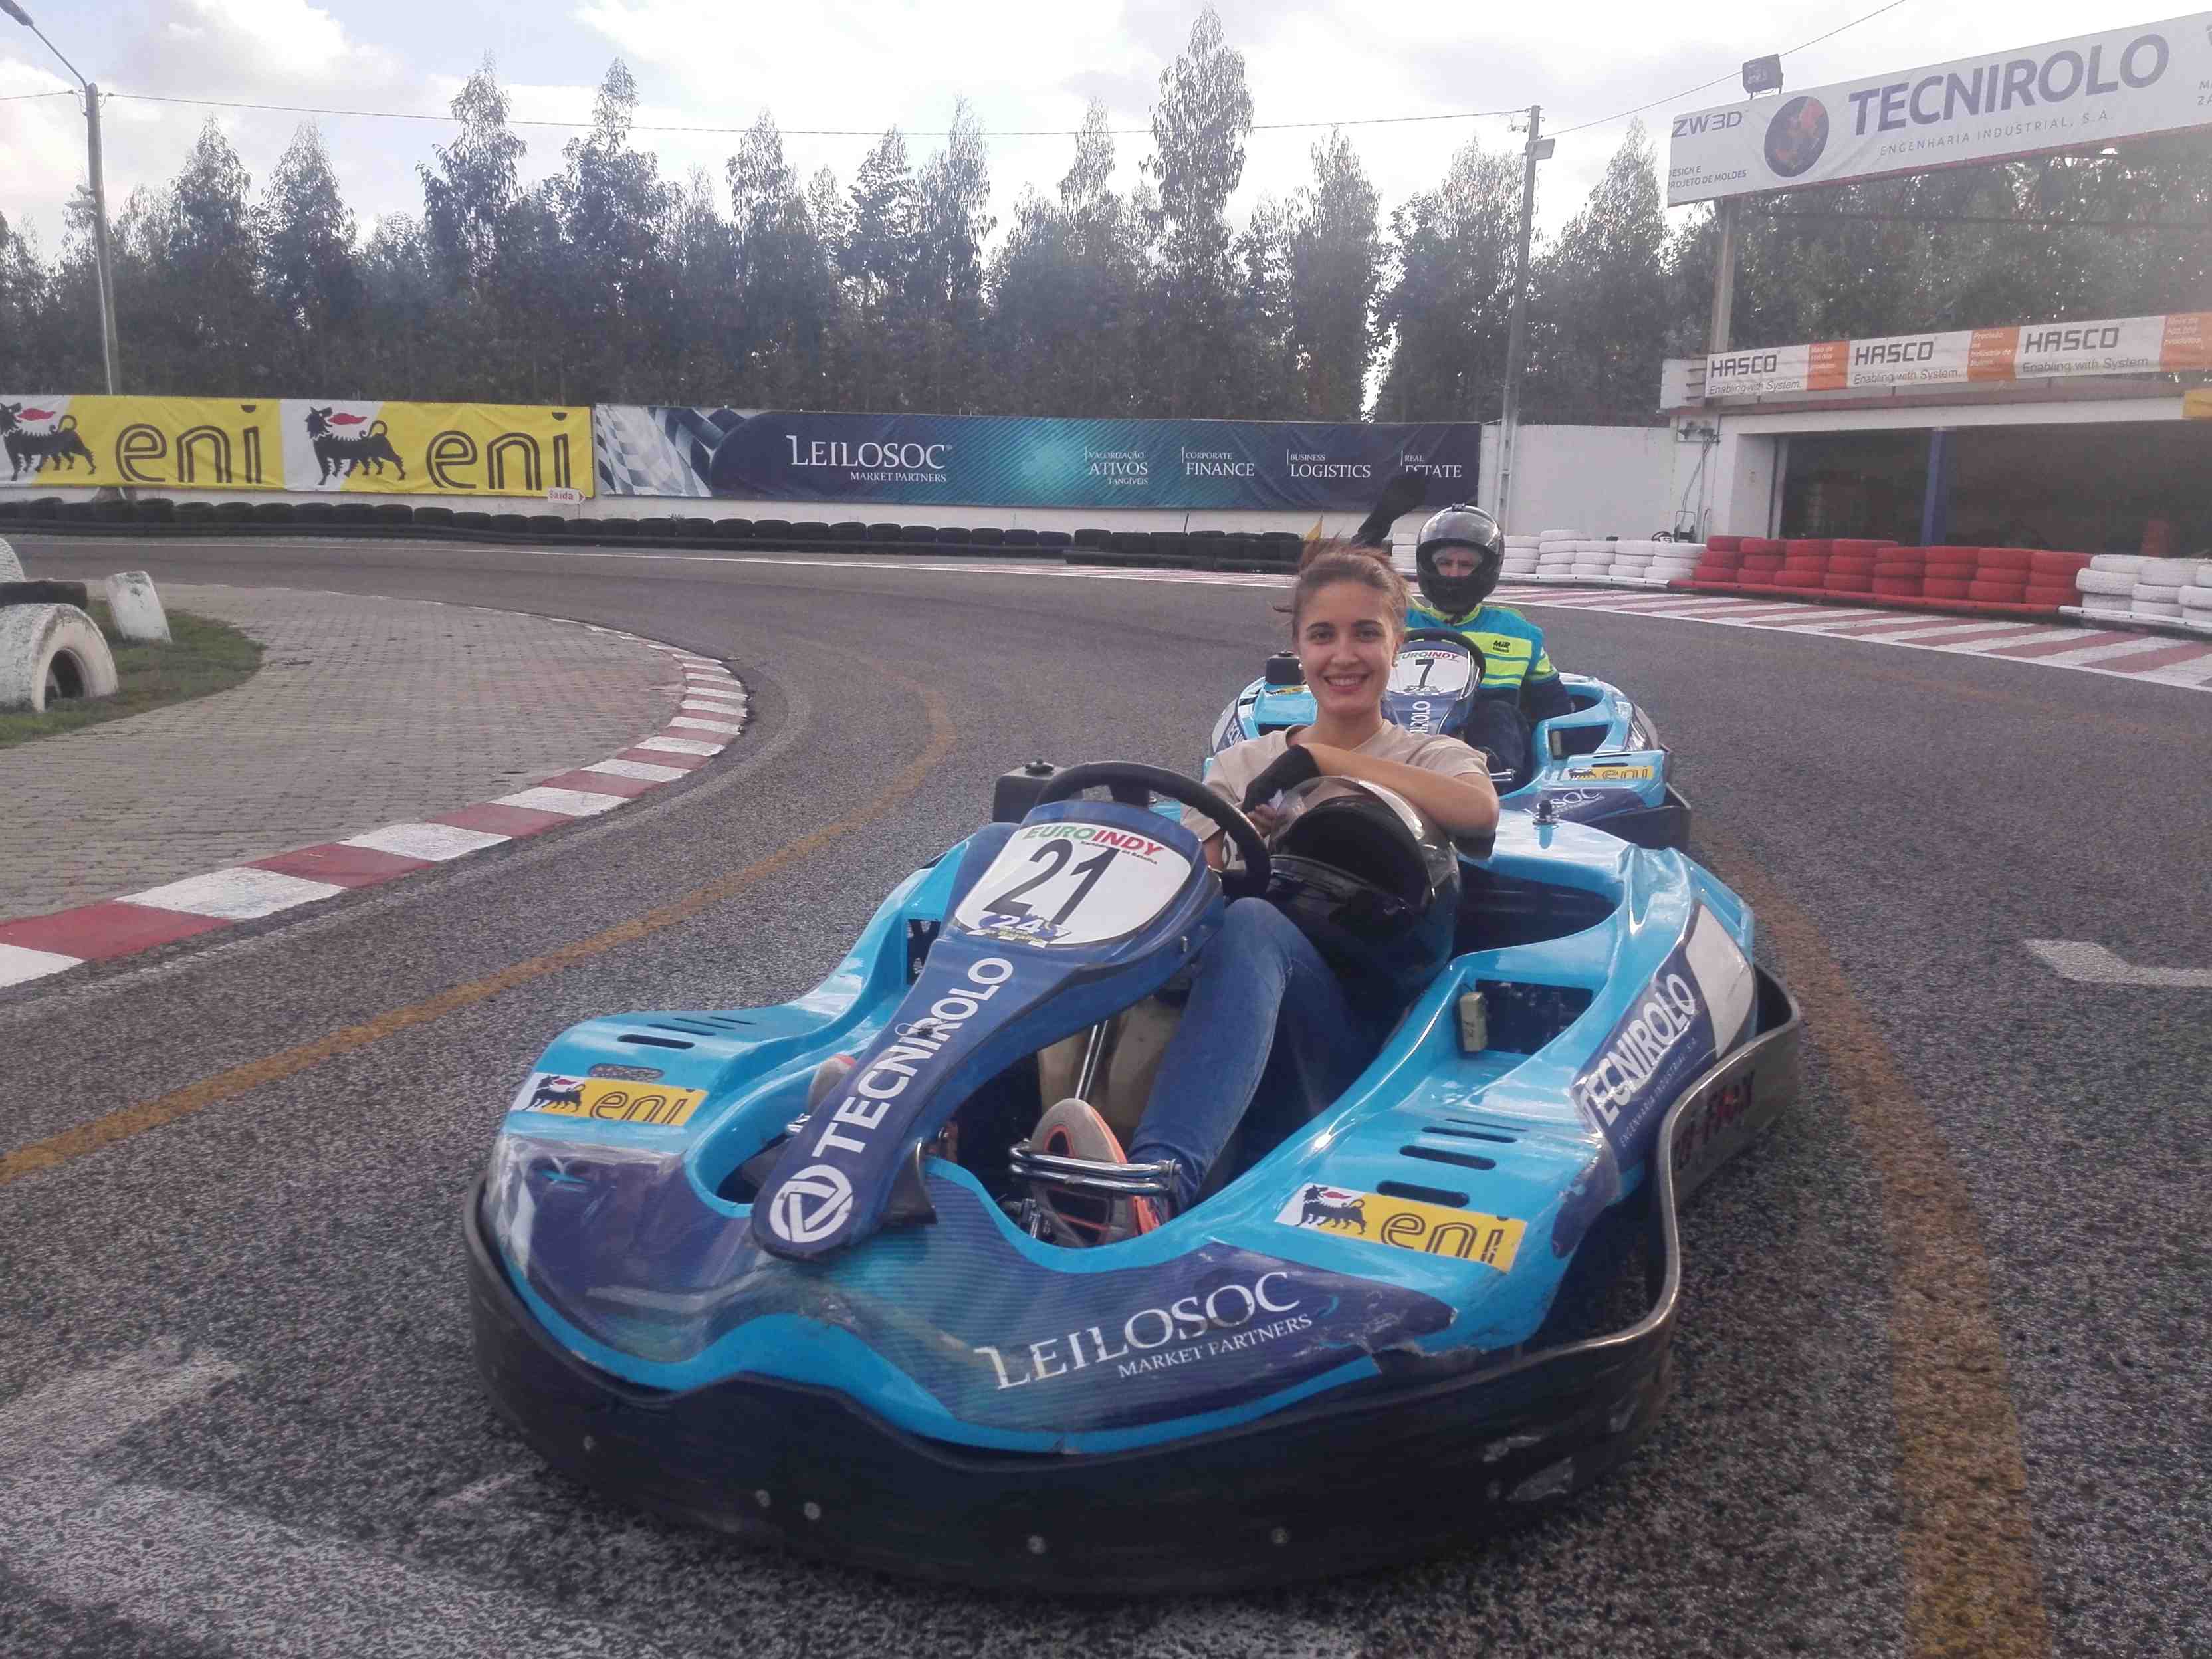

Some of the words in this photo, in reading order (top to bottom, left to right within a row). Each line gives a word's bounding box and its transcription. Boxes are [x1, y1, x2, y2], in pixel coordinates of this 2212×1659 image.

[1848, 33, 2169, 136] TECNIROLO
[1672, 110, 1743, 138] ZW3D
[1880, 132, 1970, 156] ENGENHARIA
[1977, 116, 2074, 141] INDUSTRIAL,
[1714, 169, 1747, 182] MOLDES
[1855, 341, 1934, 366] HASCO
[2025, 327, 2120, 353] HASCO
[1711, 354, 1777, 378] HASCO
[1854, 373, 1894, 385] Enabling
[1897, 370, 1917, 380] with
[2023, 361, 2072, 373] Enabling
[2074, 359, 2098, 370] with
[1710, 383, 1747, 395] Enabling
[1747, 382, 1763, 391] with
[116, 405, 261, 483] eni
[425, 412, 568, 490] eni
[786, 435, 946, 469] LEILOSOC
[1185, 451, 1232, 460] CORPORATE
[850, 471, 892, 481] MARKET
[895, 472, 946, 483] PARTNERS
[1088, 462, 1148, 475] ATIVOS
[1186, 462, 1255, 477] FINANCE
[1291, 464, 1371, 478] LOGISTICS
[1415, 659, 1435, 688] 7
[1410, 701, 1431, 733] IROLO
[1602, 766, 1648, 780] eni
[1024, 826, 1165, 856] EUROINDY
[984, 839, 1121, 927] 21
[812, 958, 1014, 1157] TECNIROLO
[1579, 974, 1697, 1134] TECNIROLO
[590, 1088, 695, 1125] eni
[1381, 1213, 1509, 1264] eni
[974, 1272, 1300, 1390] LEILOSOC
[1119, 1346, 1203, 1379] MARKET
[1208, 1313, 1313, 1357] PARTNERS
